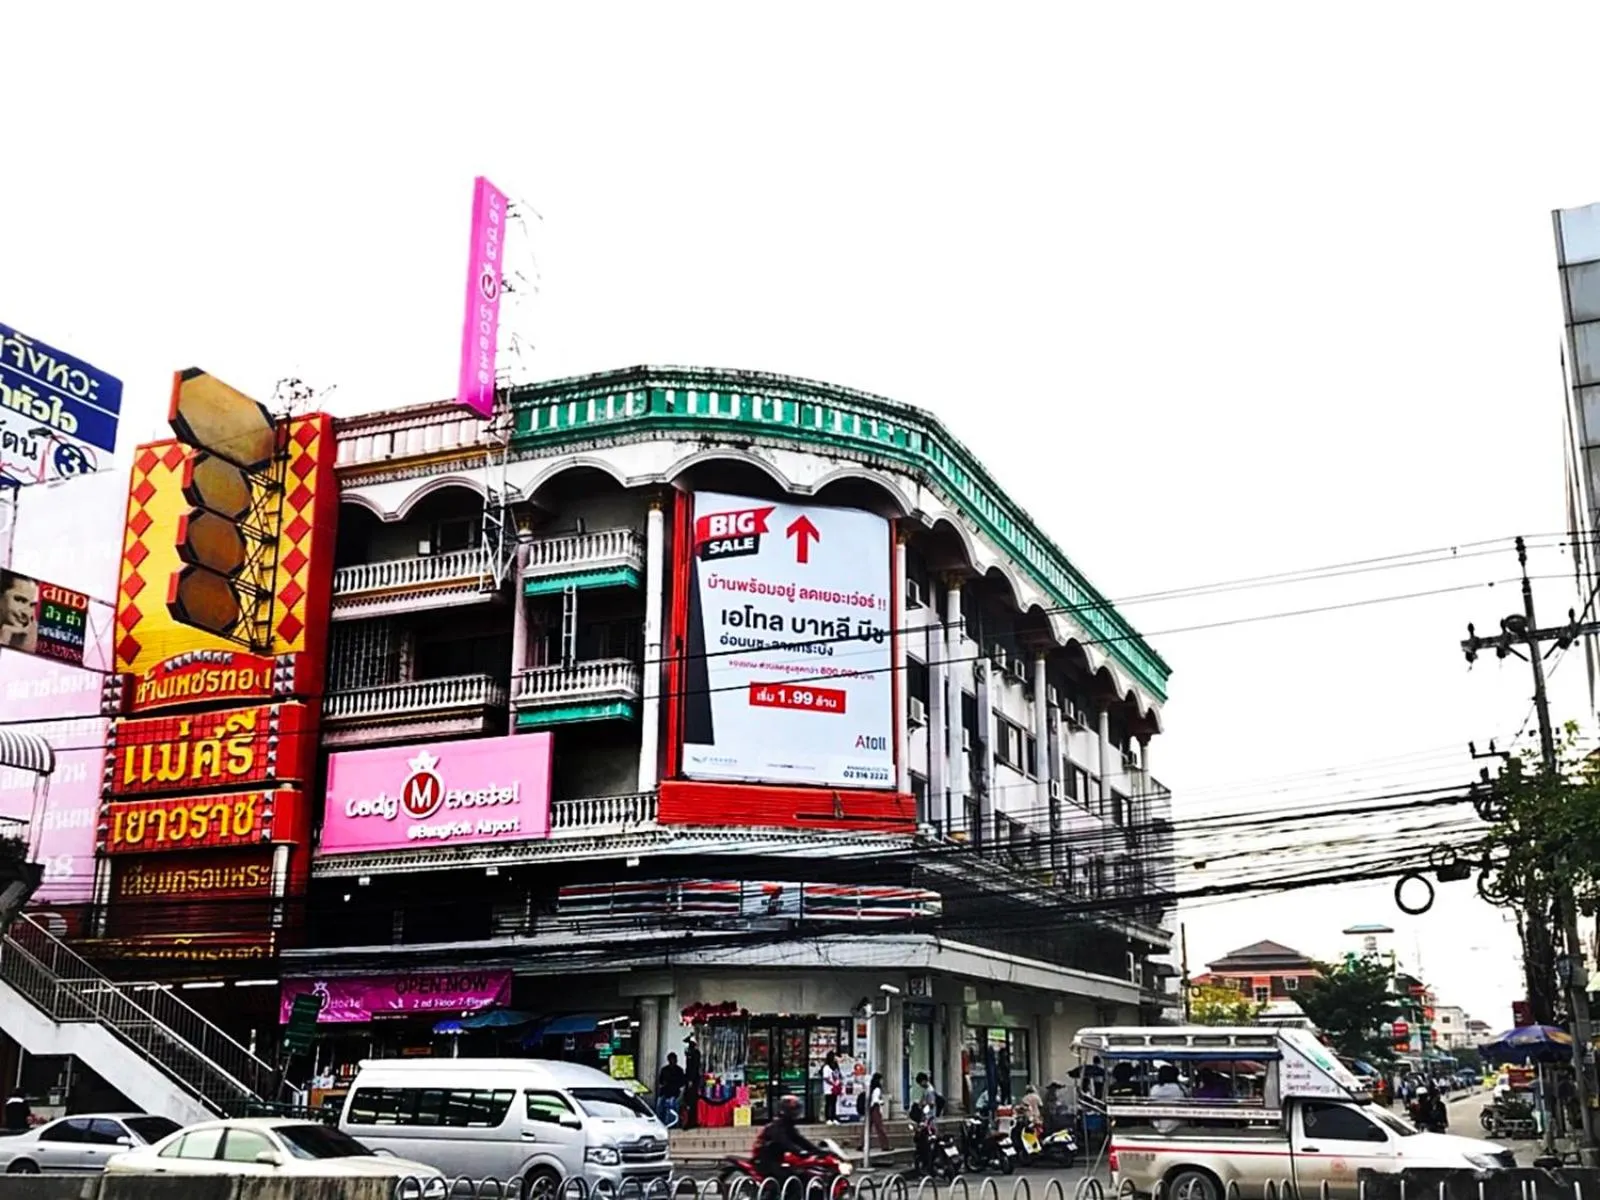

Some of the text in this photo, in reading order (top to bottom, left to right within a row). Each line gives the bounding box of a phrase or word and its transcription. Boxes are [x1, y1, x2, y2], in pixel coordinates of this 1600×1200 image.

[0, 332, 100, 401] จังหวะ
[708, 510, 756, 539] BIG
[708, 536, 755, 556] SALE
[707, 573, 796, 603] บ้านพร้อมอยู่
[721, 604, 886, 646] เอโทล บาหลี บีช
[135, 667, 272, 704] ห้างเพชรทอง
[778, 689, 813, 705] 1.99
[123, 710, 258, 786] แม่ศรี
[855, 734, 887, 751] Atoll
[113, 794, 259, 844] เยาวราช
[345, 791, 400, 821] Lady
[446, 780, 521, 809] Hostel
